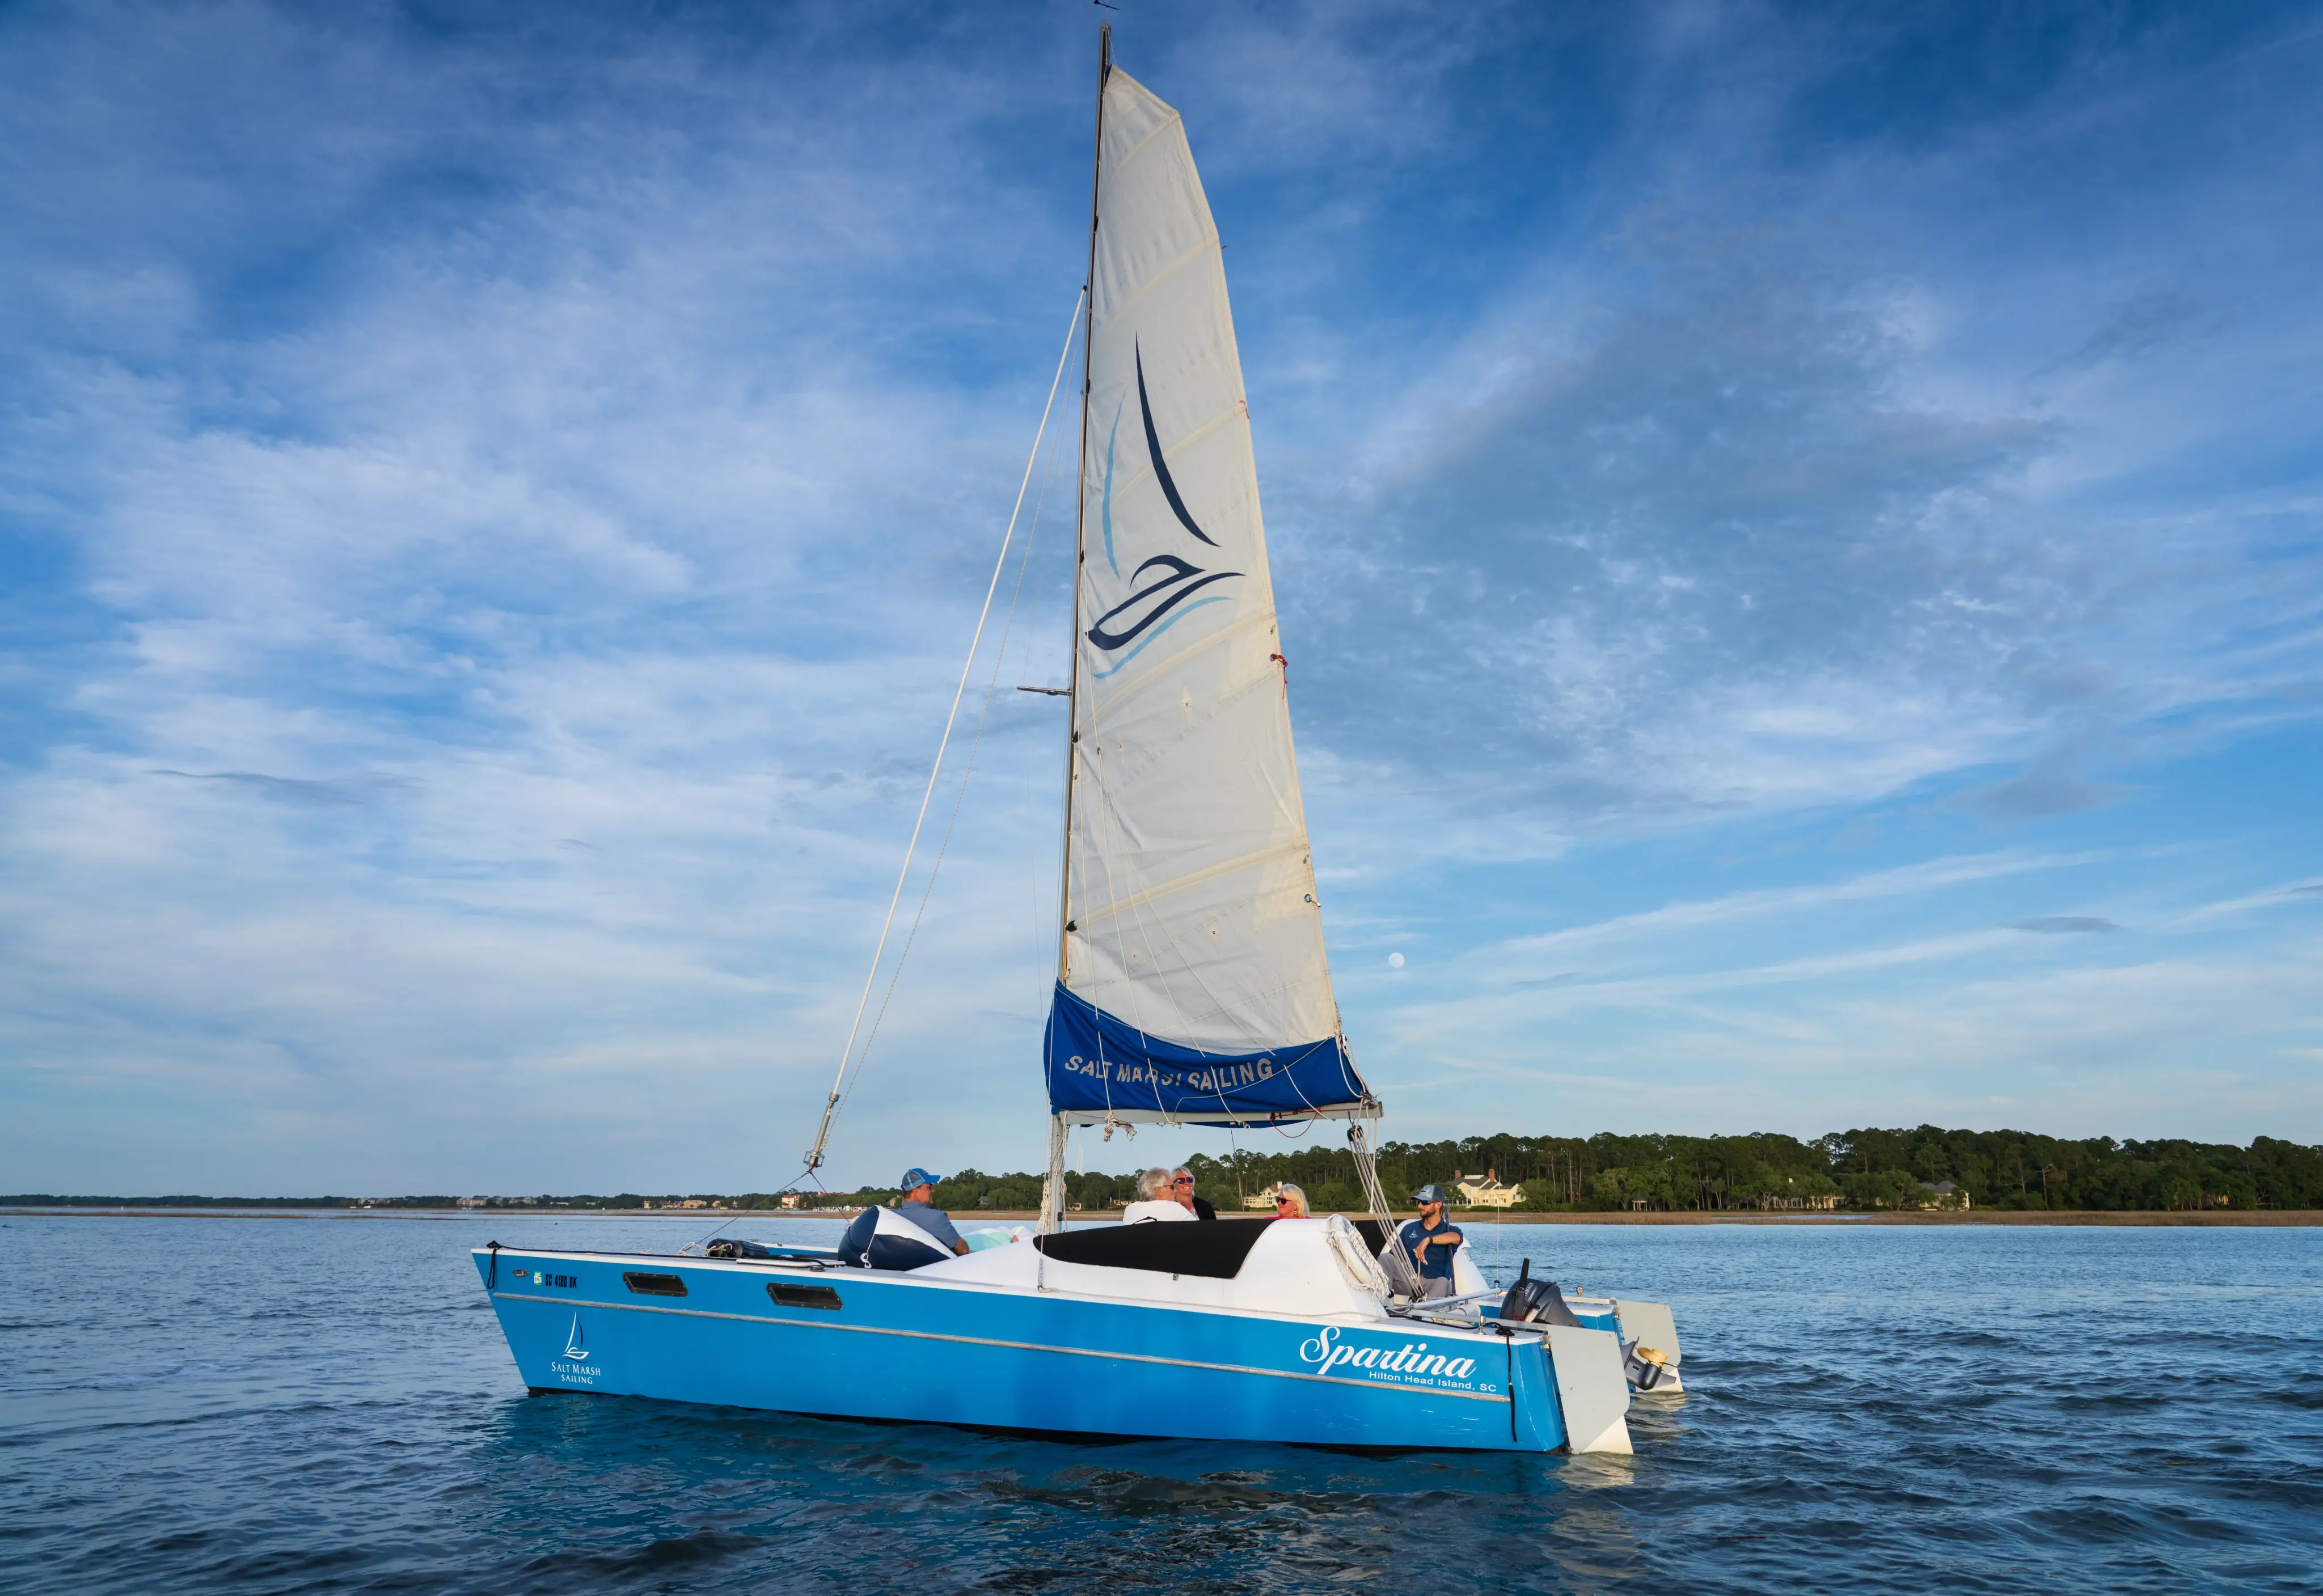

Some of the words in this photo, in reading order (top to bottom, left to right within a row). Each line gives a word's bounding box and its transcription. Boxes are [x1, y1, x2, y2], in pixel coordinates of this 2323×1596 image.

[1065, 1056, 1113, 1079] SALT
[1188, 1058, 1272, 1091] SAILING
[546, 1274, 552, 1286] SC
[569, 1276, 577, 1288] DK
[1299, 1326, 1477, 1378] Spartina
[552, 1362, 570, 1373] SALT
[573, 1364, 601, 1376] MARSH
[561, 1374, 593, 1384] SAILING
[1369, 1371, 1400, 1382] Hilton
[1405, 1375, 1434, 1385] Head
[1438, 1378, 1475, 1391] Island,
[1480, 1383, 1497, 1392] SC
